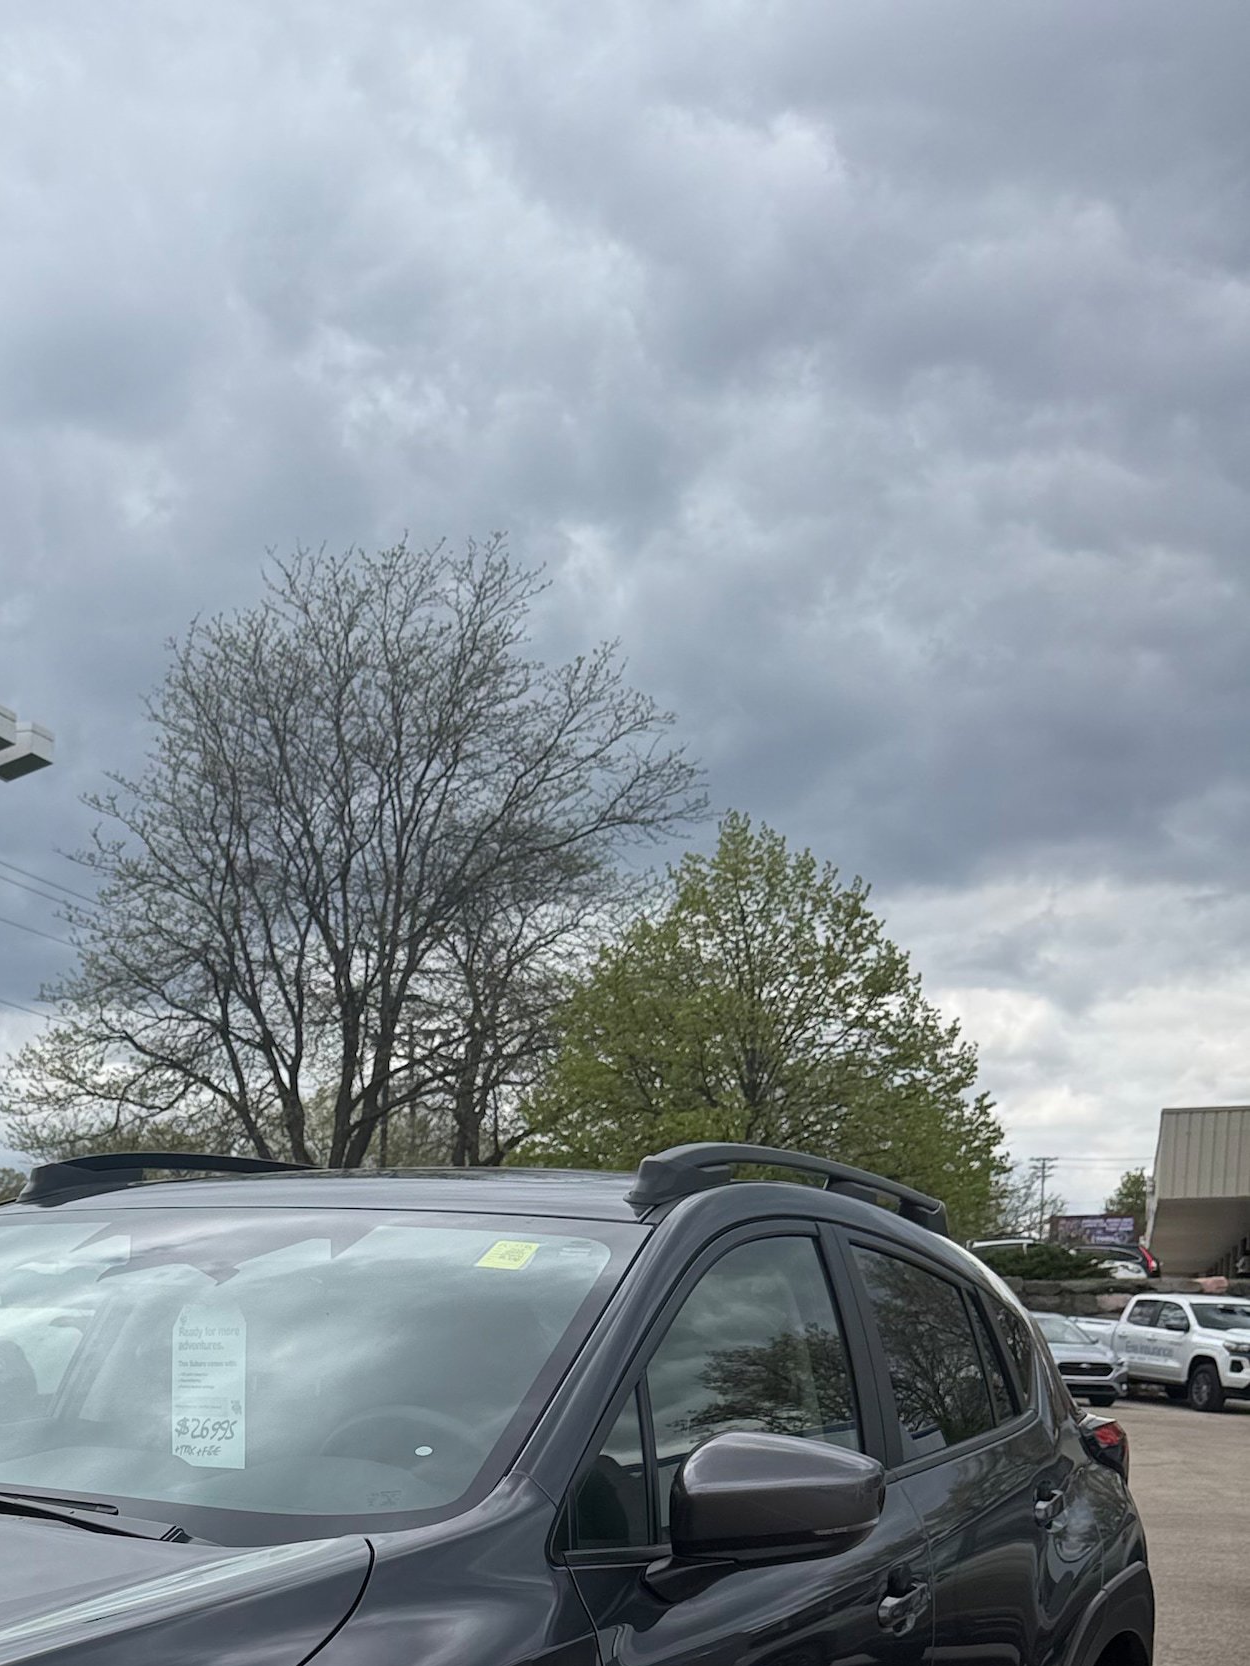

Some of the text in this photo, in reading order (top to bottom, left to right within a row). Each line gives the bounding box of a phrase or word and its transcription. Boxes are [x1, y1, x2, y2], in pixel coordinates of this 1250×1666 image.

[178, 1327, 240, 1339] Ready for more
[174, 1417, 238, 1441] $26995
